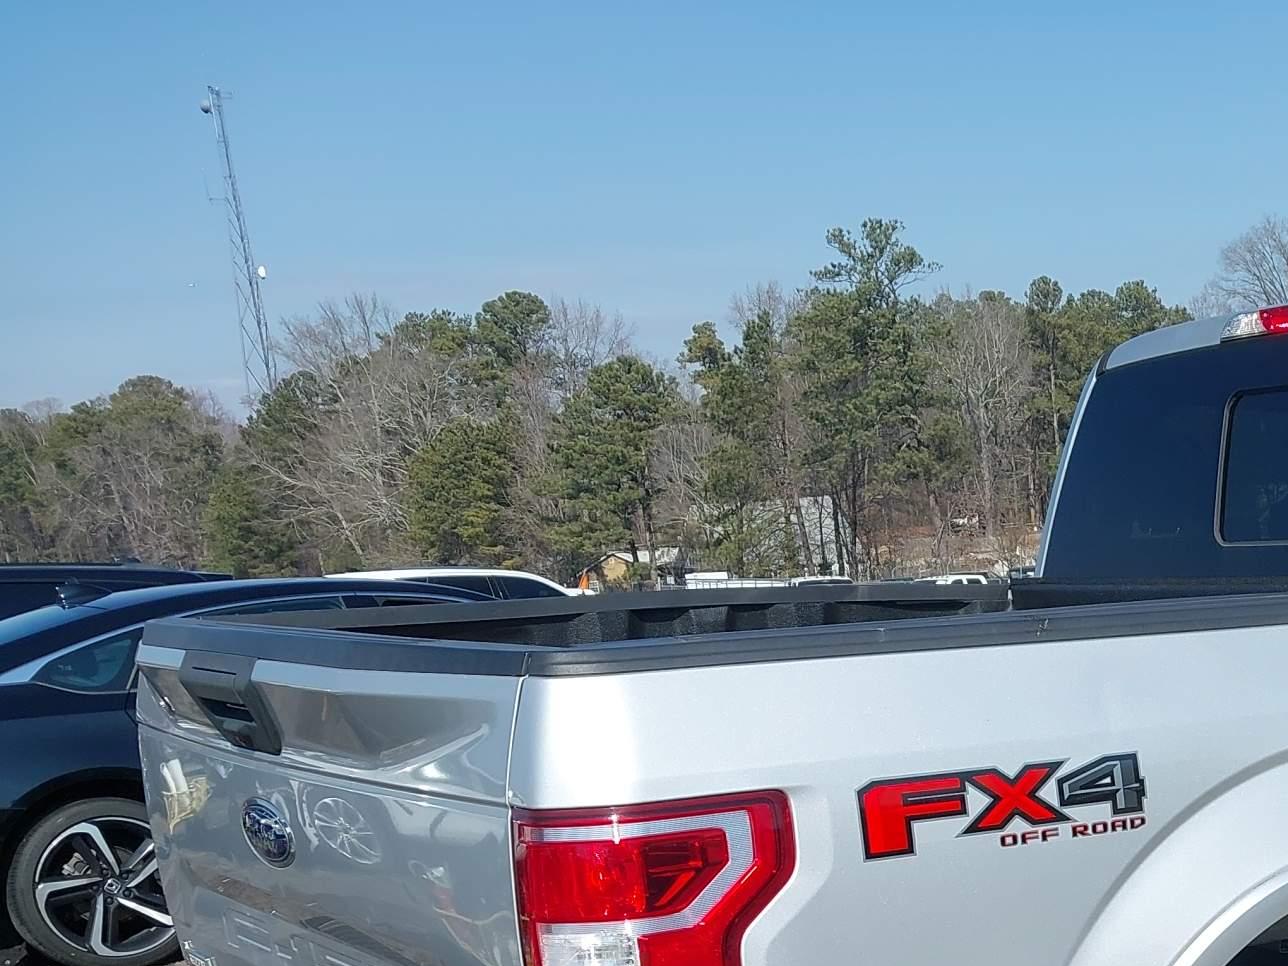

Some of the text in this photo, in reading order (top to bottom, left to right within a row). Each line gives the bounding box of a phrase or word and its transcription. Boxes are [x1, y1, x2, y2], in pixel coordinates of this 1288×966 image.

[855, 751, 1148, 863] FX4
[1000, 816, 1146, 848] OFF ROAD
